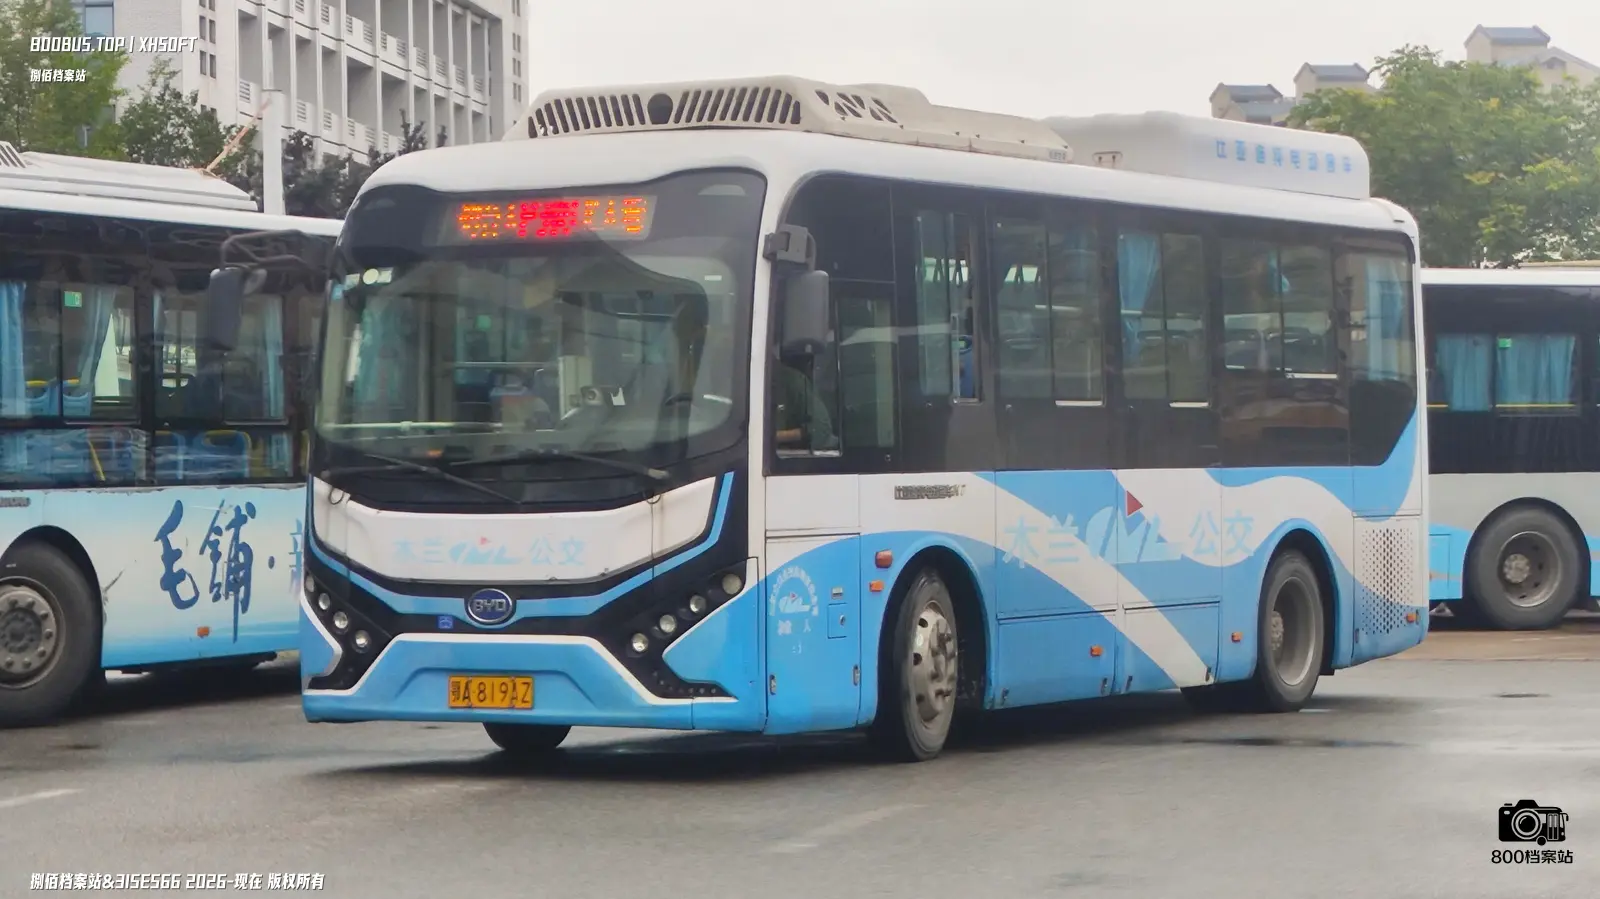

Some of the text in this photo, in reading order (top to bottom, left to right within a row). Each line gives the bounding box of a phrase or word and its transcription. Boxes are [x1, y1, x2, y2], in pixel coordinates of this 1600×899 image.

[529, 536, 586, 566] 公交
[1002, 512, 1080, 569] 木兰
[1189, 508, 1255, 557] 公交
[474, 598, 507, 613] BYD
